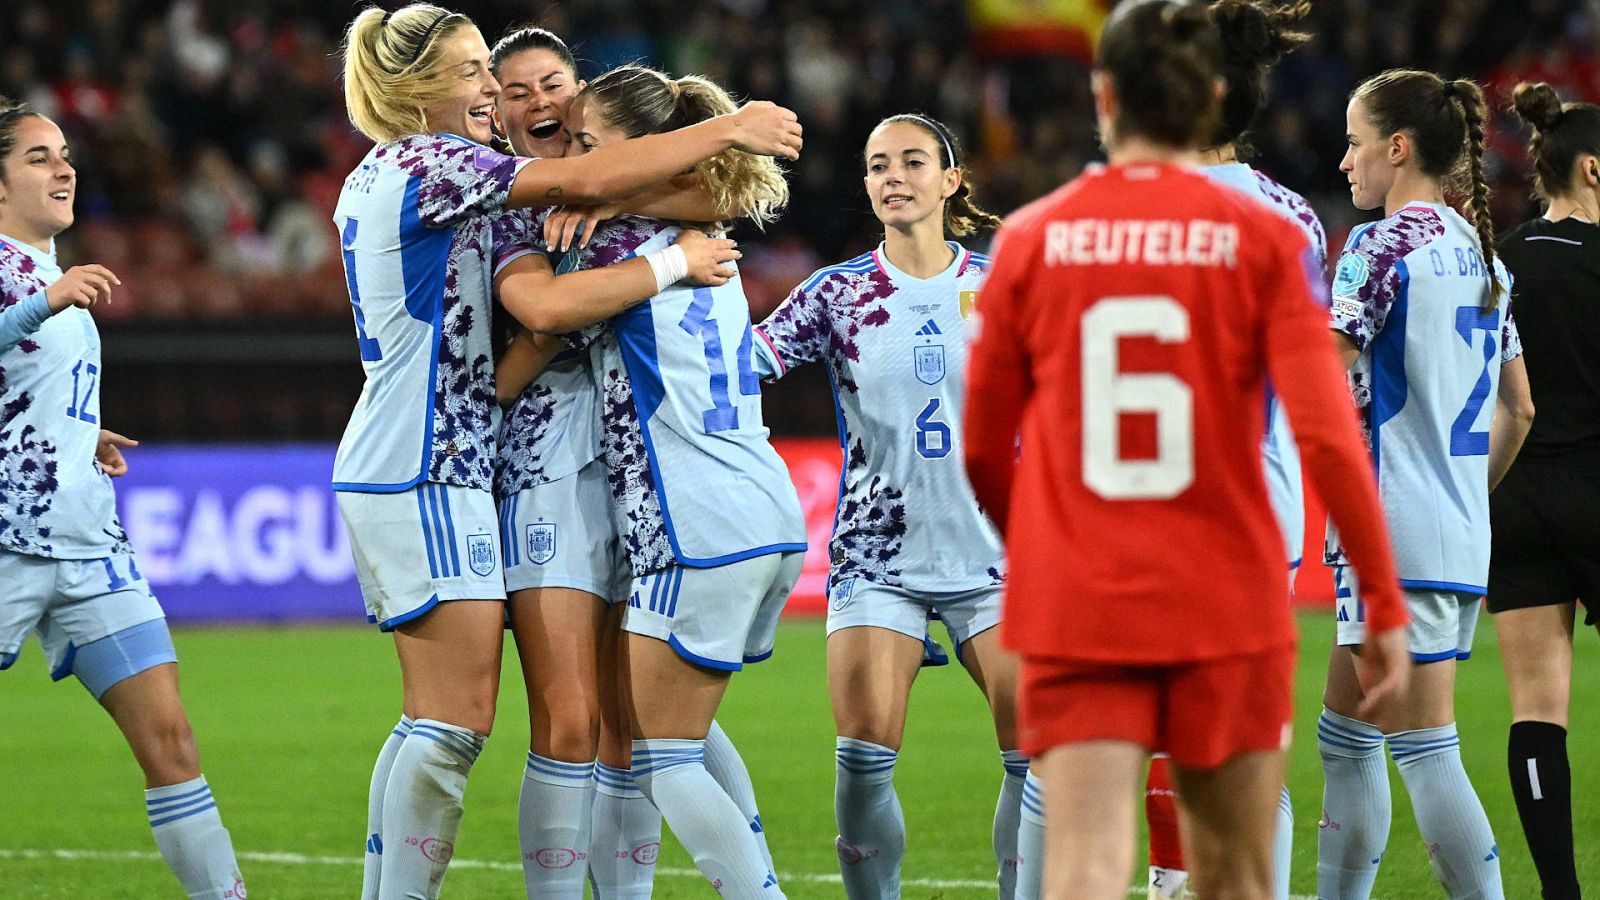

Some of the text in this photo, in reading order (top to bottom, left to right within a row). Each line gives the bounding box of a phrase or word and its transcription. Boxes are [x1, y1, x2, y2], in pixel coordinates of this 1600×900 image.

[1044, 219, 1239, 269] REUTELER
[66, 359, 98, 425] 12
[1080, 295, 1194, 500] 6
[1450, 306, 1500, 457] 2
[914, 397, 952, 459] 6
[125, 484, 357, 586] EAGU
